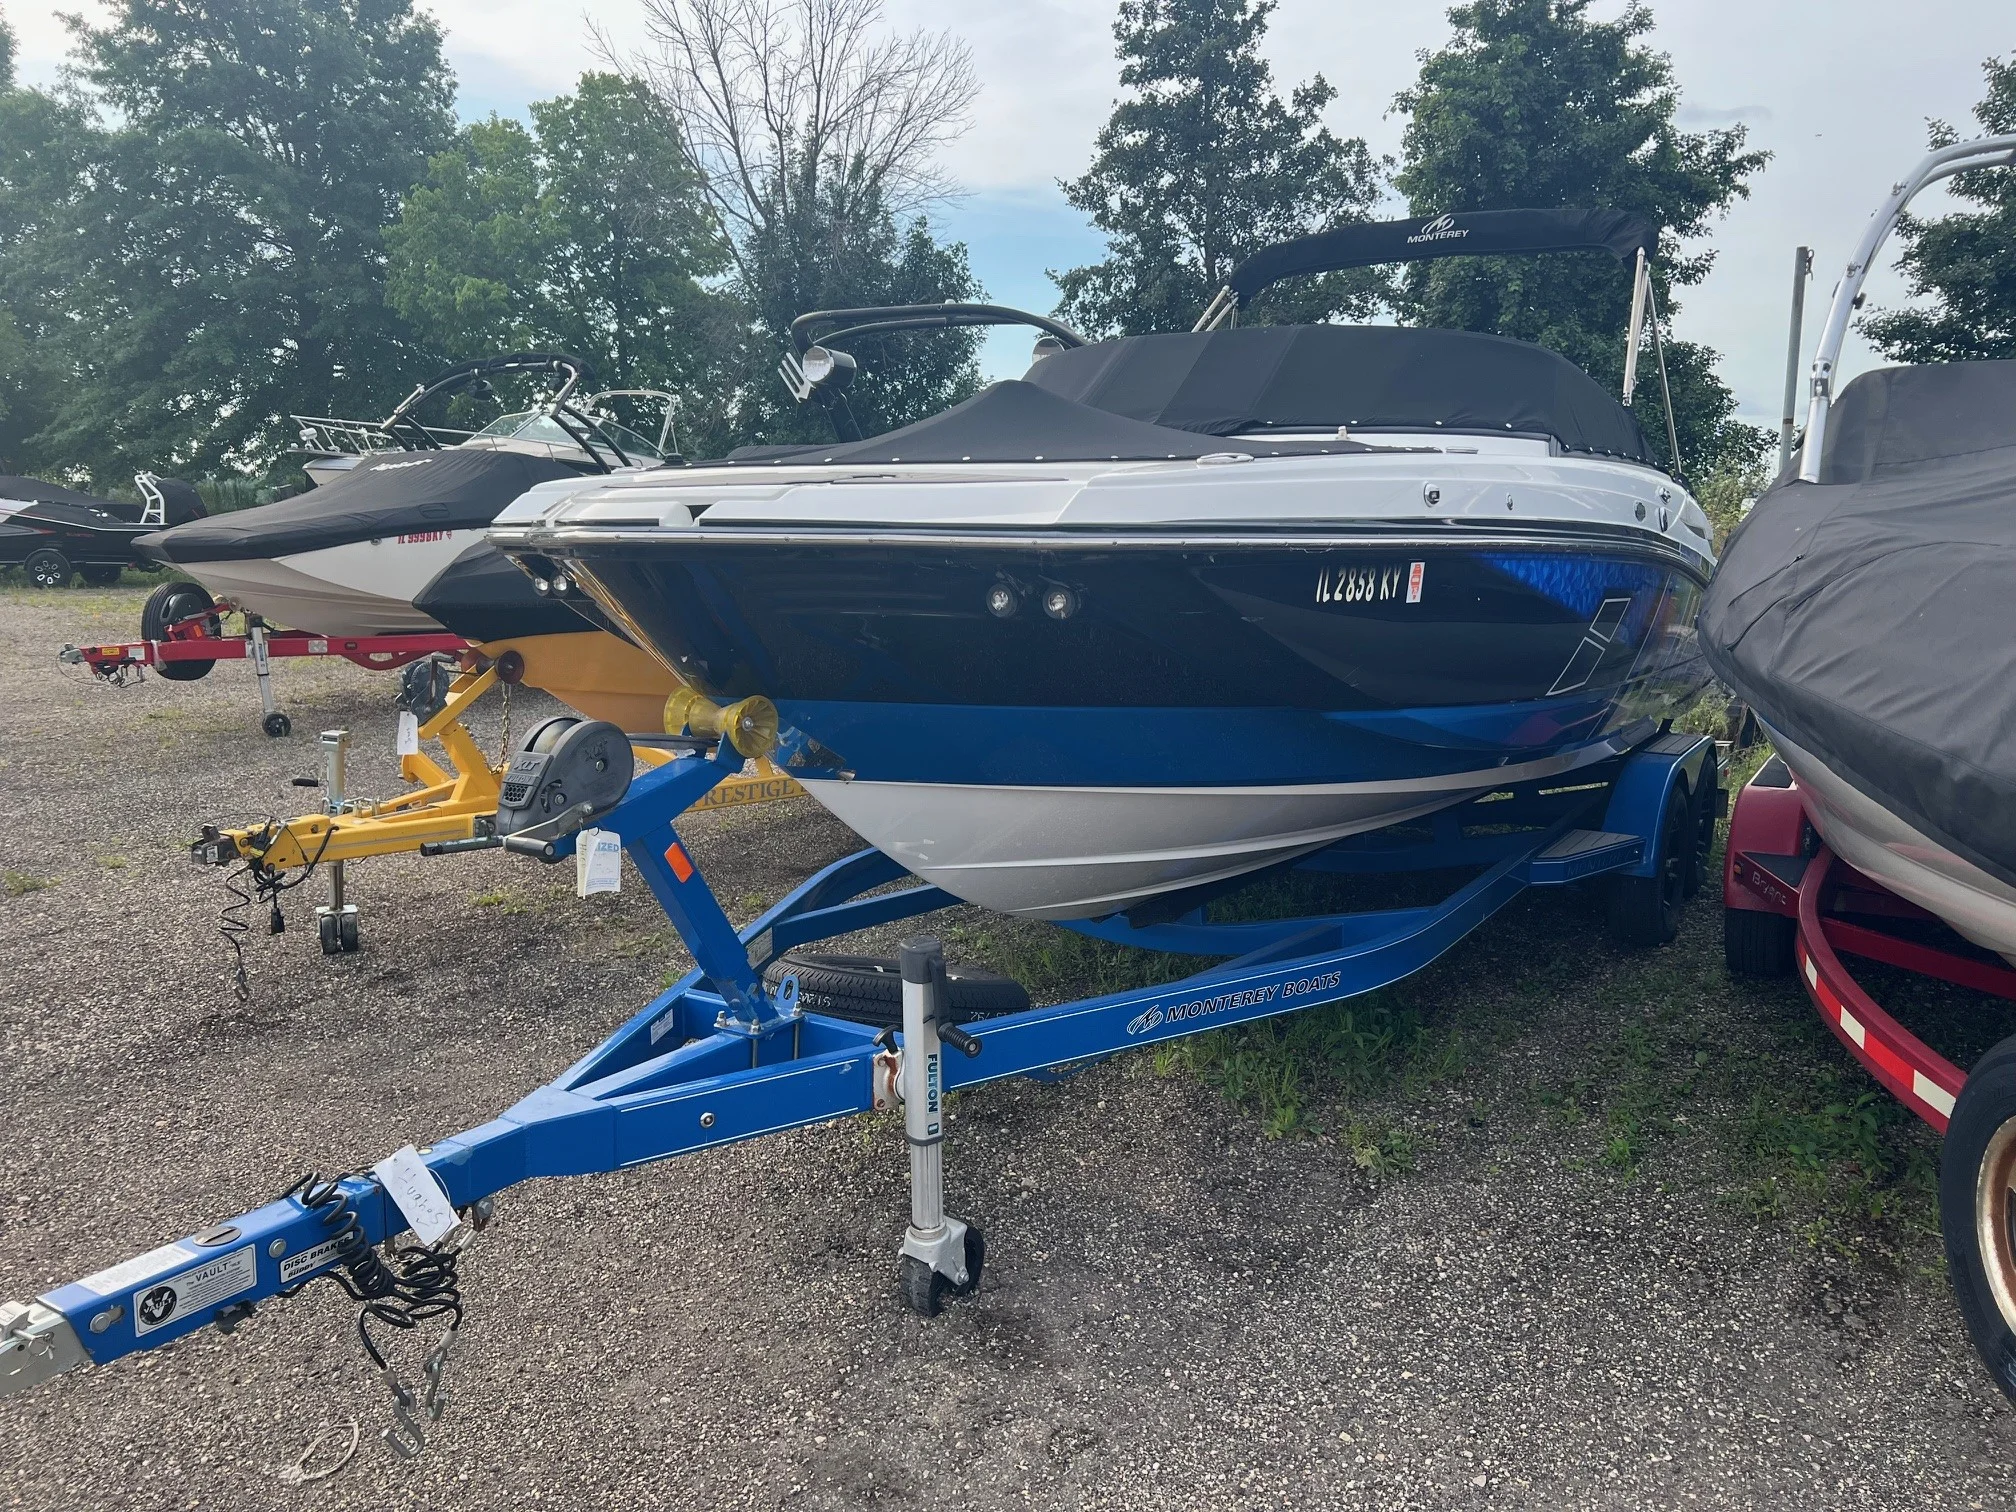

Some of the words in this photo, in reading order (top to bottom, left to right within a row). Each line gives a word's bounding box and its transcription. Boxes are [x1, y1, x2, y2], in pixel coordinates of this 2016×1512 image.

[1407, 229, 1470, 244] MONTEREY
[1316, 565, 1330, 603] IL
[1334, 566, 1376, 602] 2858
[1380, 565, 1402, 600] KY
[595, 842, 619, 852] IZED
[1165, 984, 1280, 1024] MONTEREY
[1282, 971, 1341, 998] BOATS
[927, 1053, 938, 1113] FULTON
[283, 1255, 308, 1272] DISC
[143, 1296, 173, 1314] VAULT
